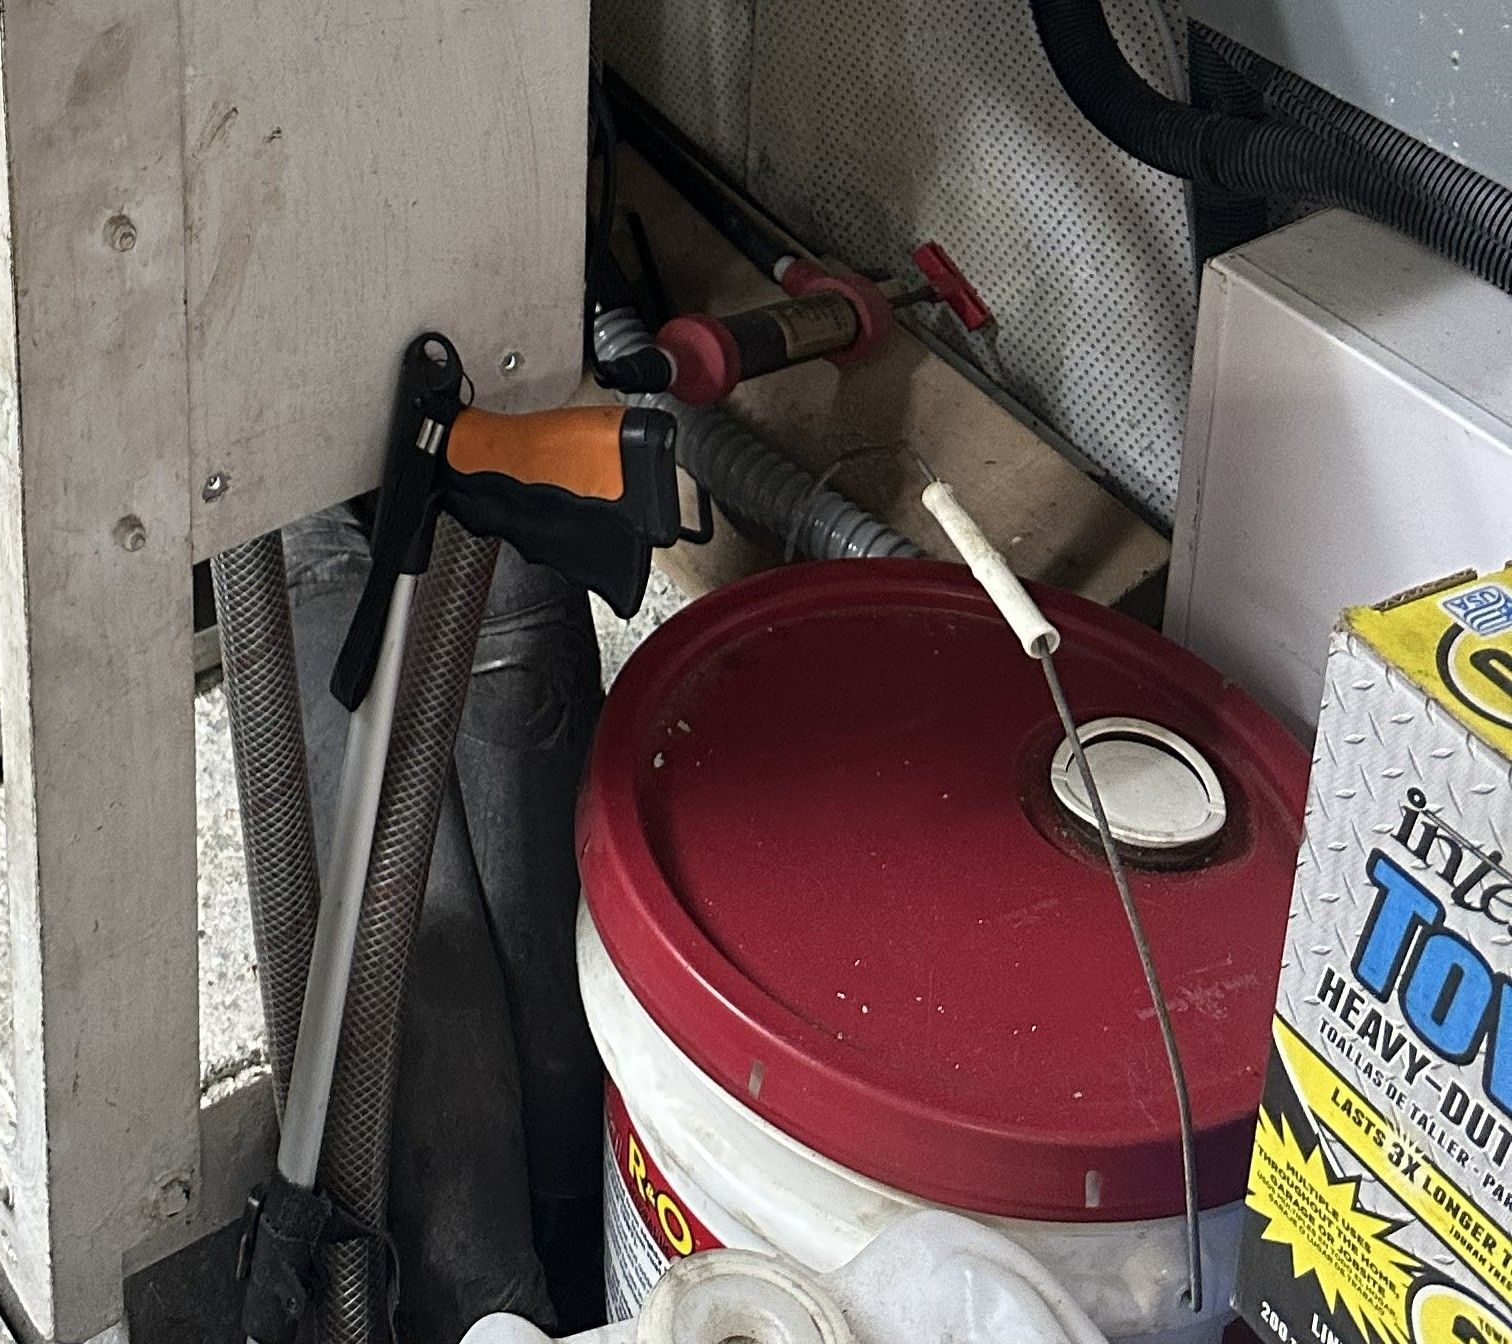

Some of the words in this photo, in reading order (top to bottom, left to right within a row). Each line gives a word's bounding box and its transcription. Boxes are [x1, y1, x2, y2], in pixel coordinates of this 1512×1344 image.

[1319, 1018, 1385, 1088] TOALLAS
[1385, 1082, 1408, 1110] DE
[1257, 1143, 1335, 1229] THROUGHOUT
[1335, 1225, 1359, 1257] THE
[1286, 1160, 1339, 1223] MULTIPLE
[1341, 1217, 1372, 1255] USES
[1330, 1086, 1387, 1148] LASTS
[1388, 1142, 1422, 1184] 3X
[1422, 1174, 1498, 1256] LONGER
[1270, 1173, 1316, 1226] GARAGE
[1318, 1224, 1335, 1245] OR
[1338, 1244, 1386, 1300] JOBSITE
[1260, 1300, 1289, 1343] 200
